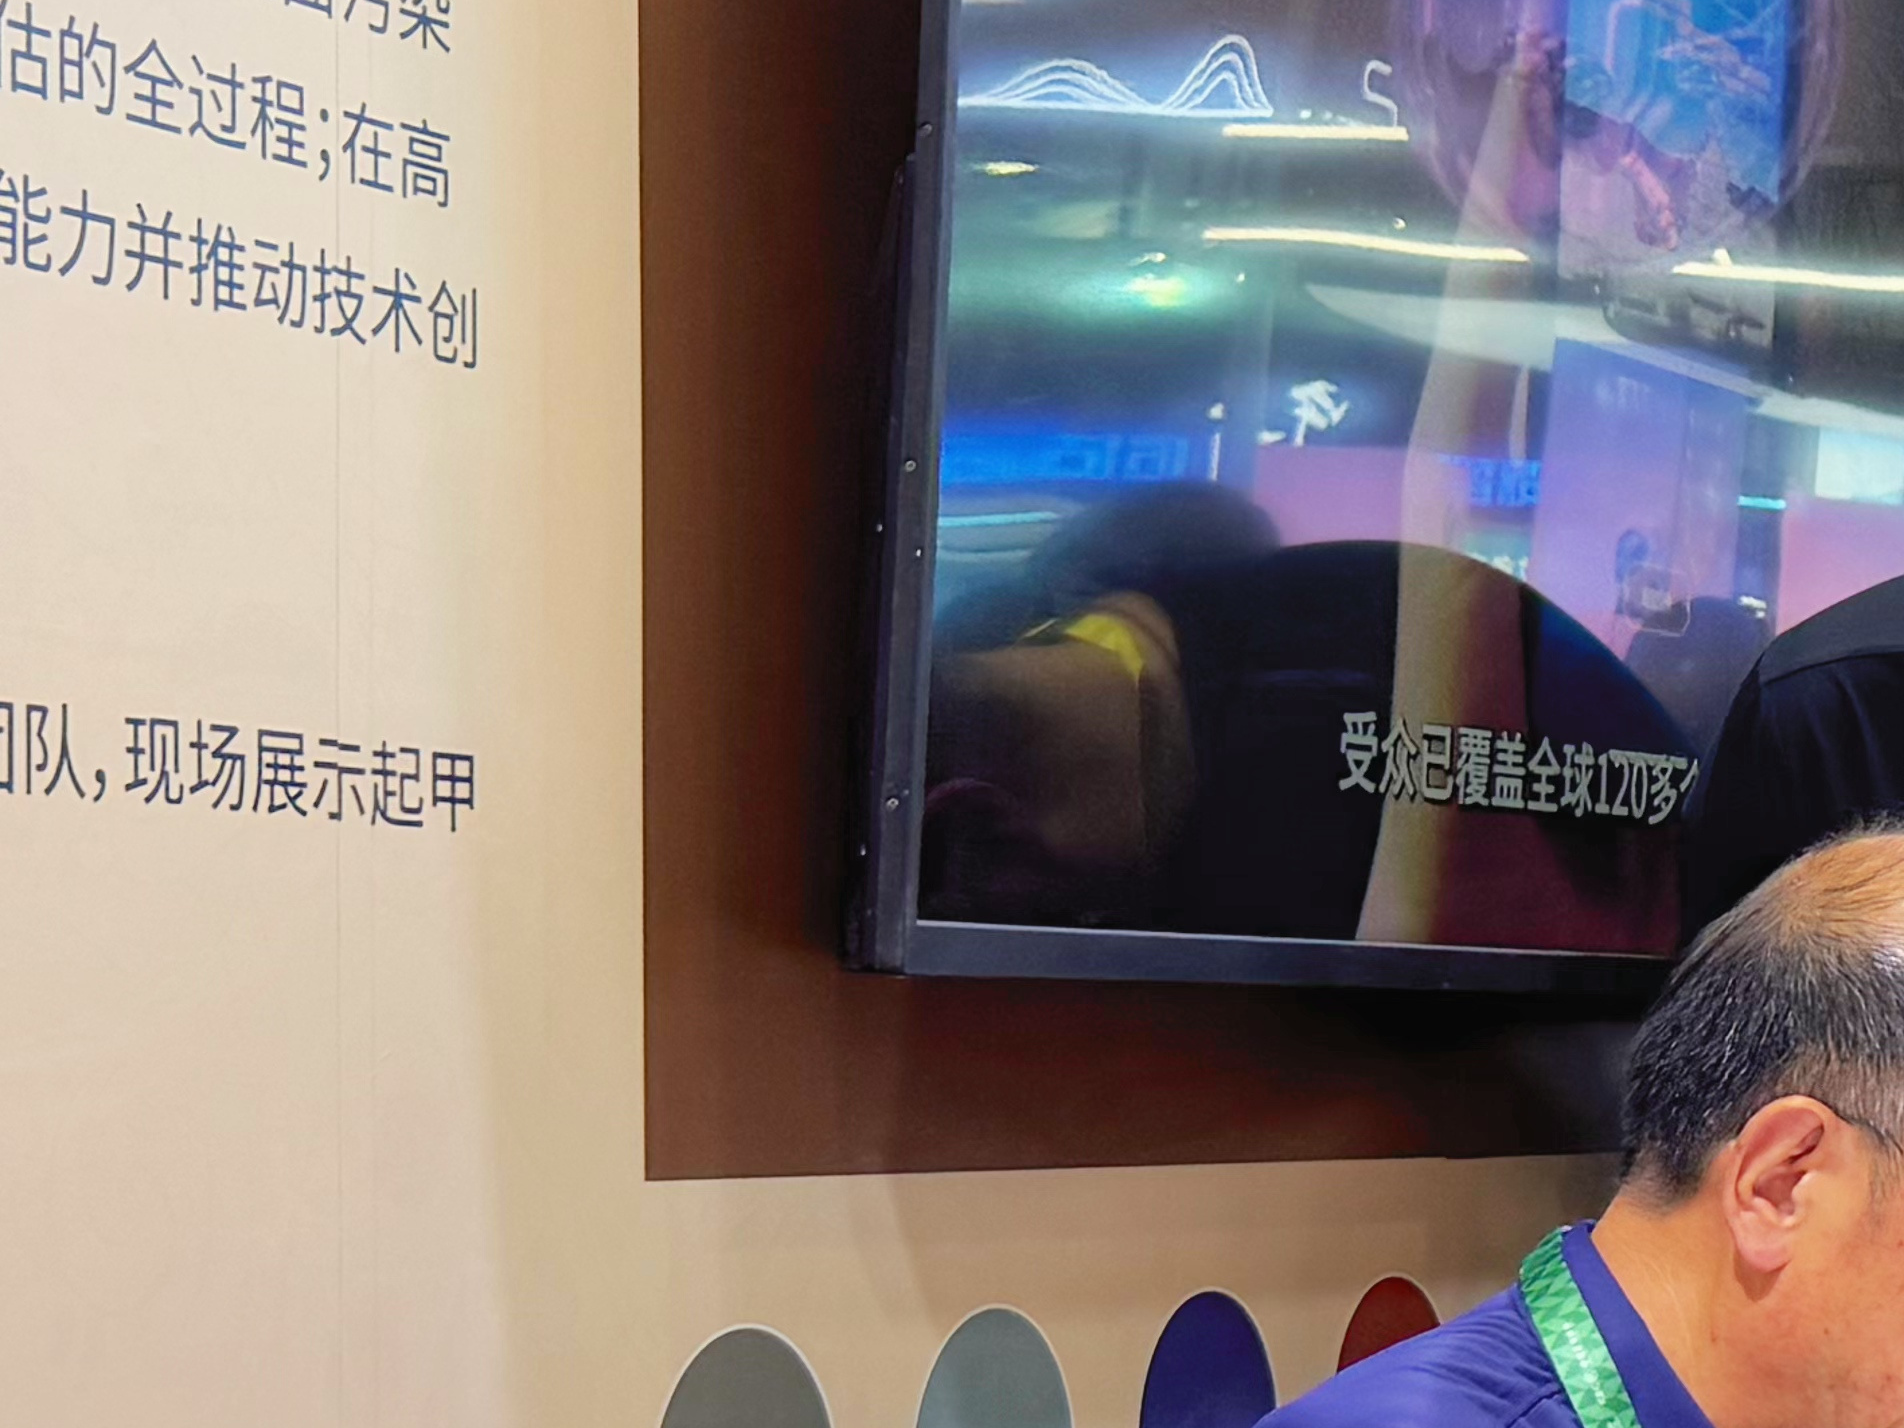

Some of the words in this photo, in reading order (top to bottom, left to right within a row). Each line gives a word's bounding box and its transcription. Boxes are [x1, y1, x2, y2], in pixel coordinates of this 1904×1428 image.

[0, 168, 478, 369] 能力并推动技术创
[0, 701, 474, 832] 队，现场展示起甲
